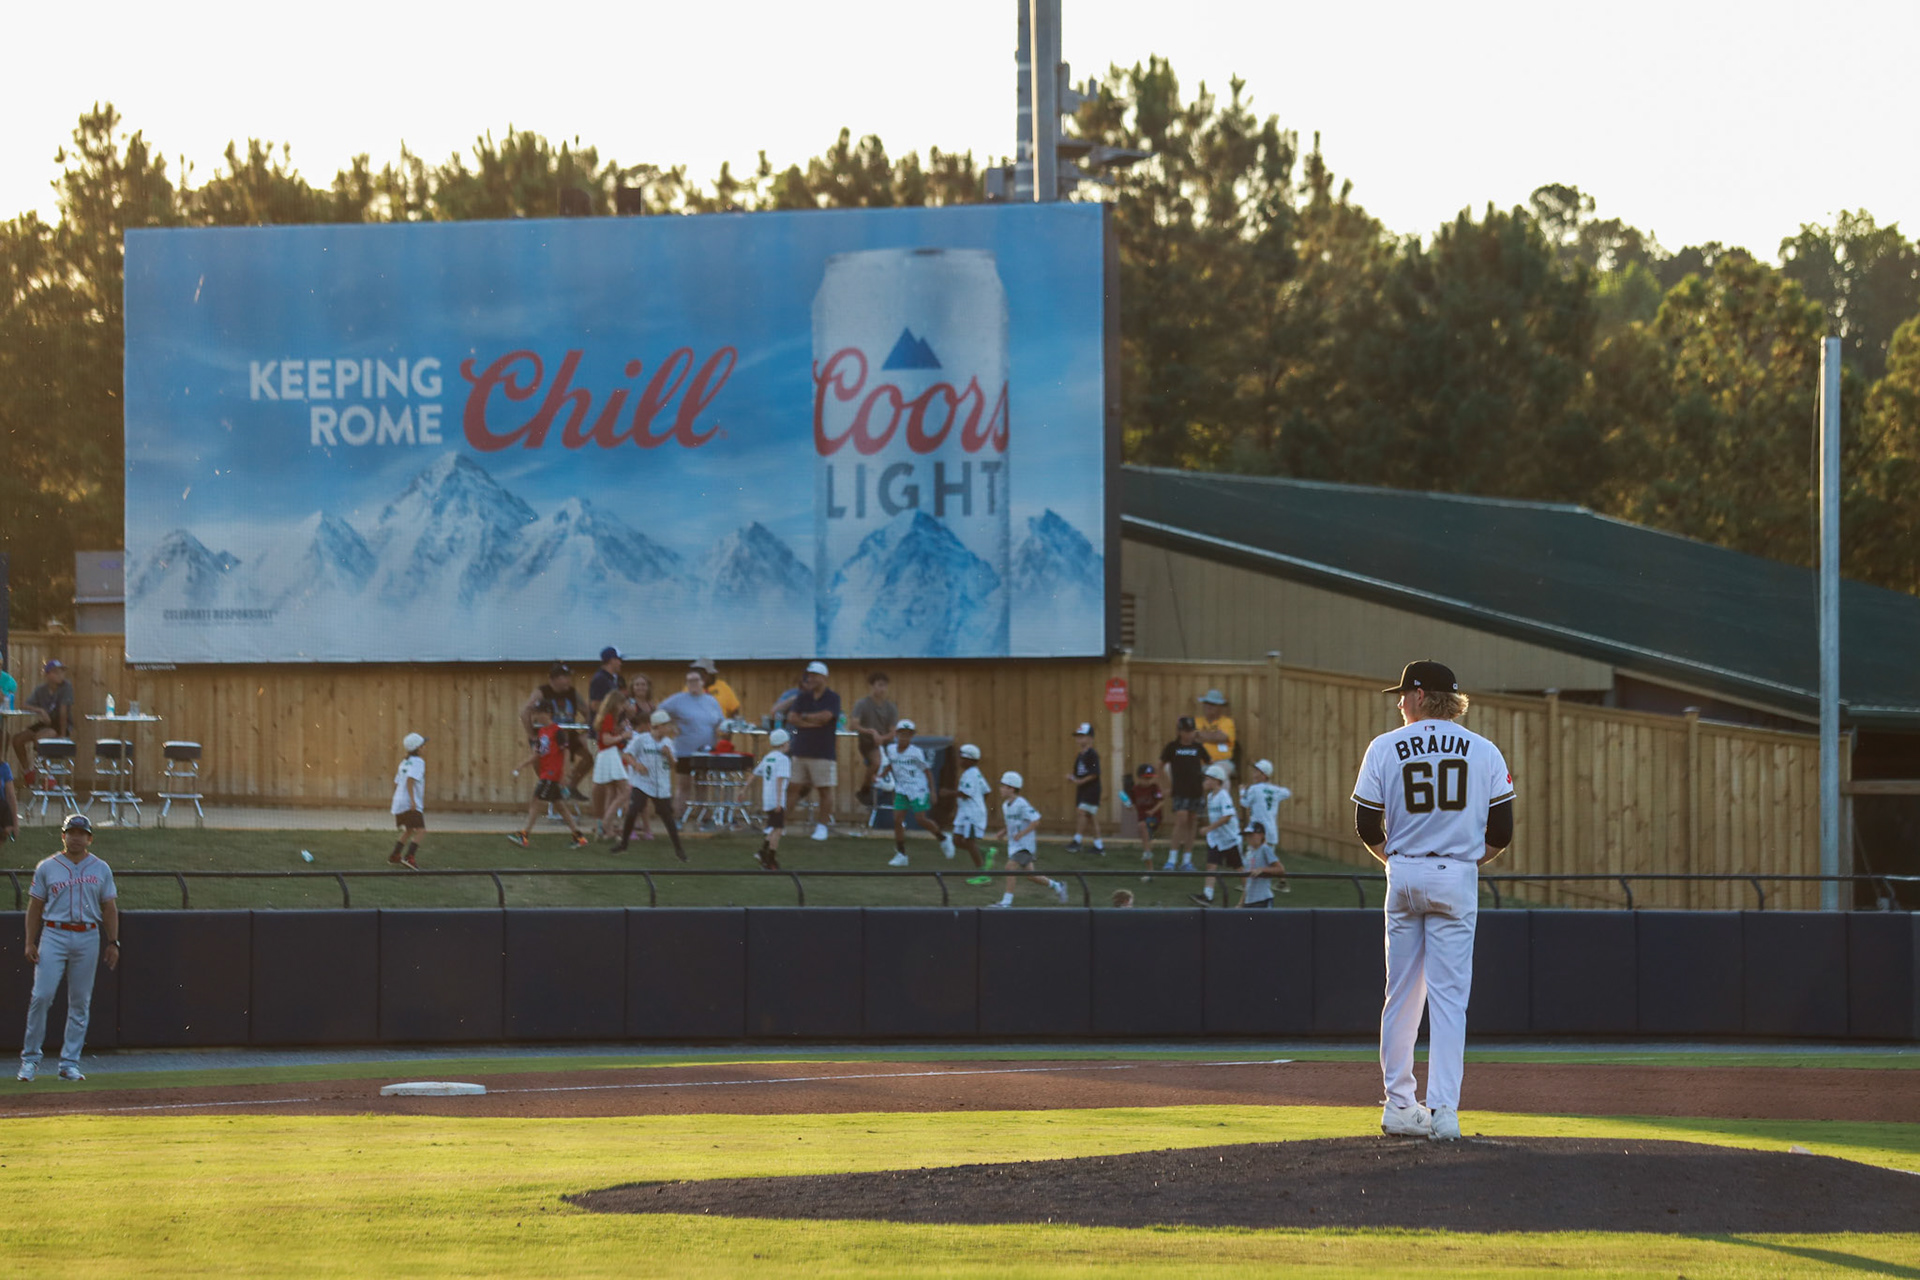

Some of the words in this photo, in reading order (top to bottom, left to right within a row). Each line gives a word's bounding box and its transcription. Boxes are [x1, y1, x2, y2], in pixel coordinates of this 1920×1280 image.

[250, 357, 442, 400] KEEPING
[459, 346, 738, 452] Chill
[812, 347, 1009, 456] Coors
[310, 404, 442, 446] ROME
[826, 461, 1004, 519] LIGHT
[1395, 735, 1470, 761] BRAUN
[1402, 758, 1468, 814] 60
